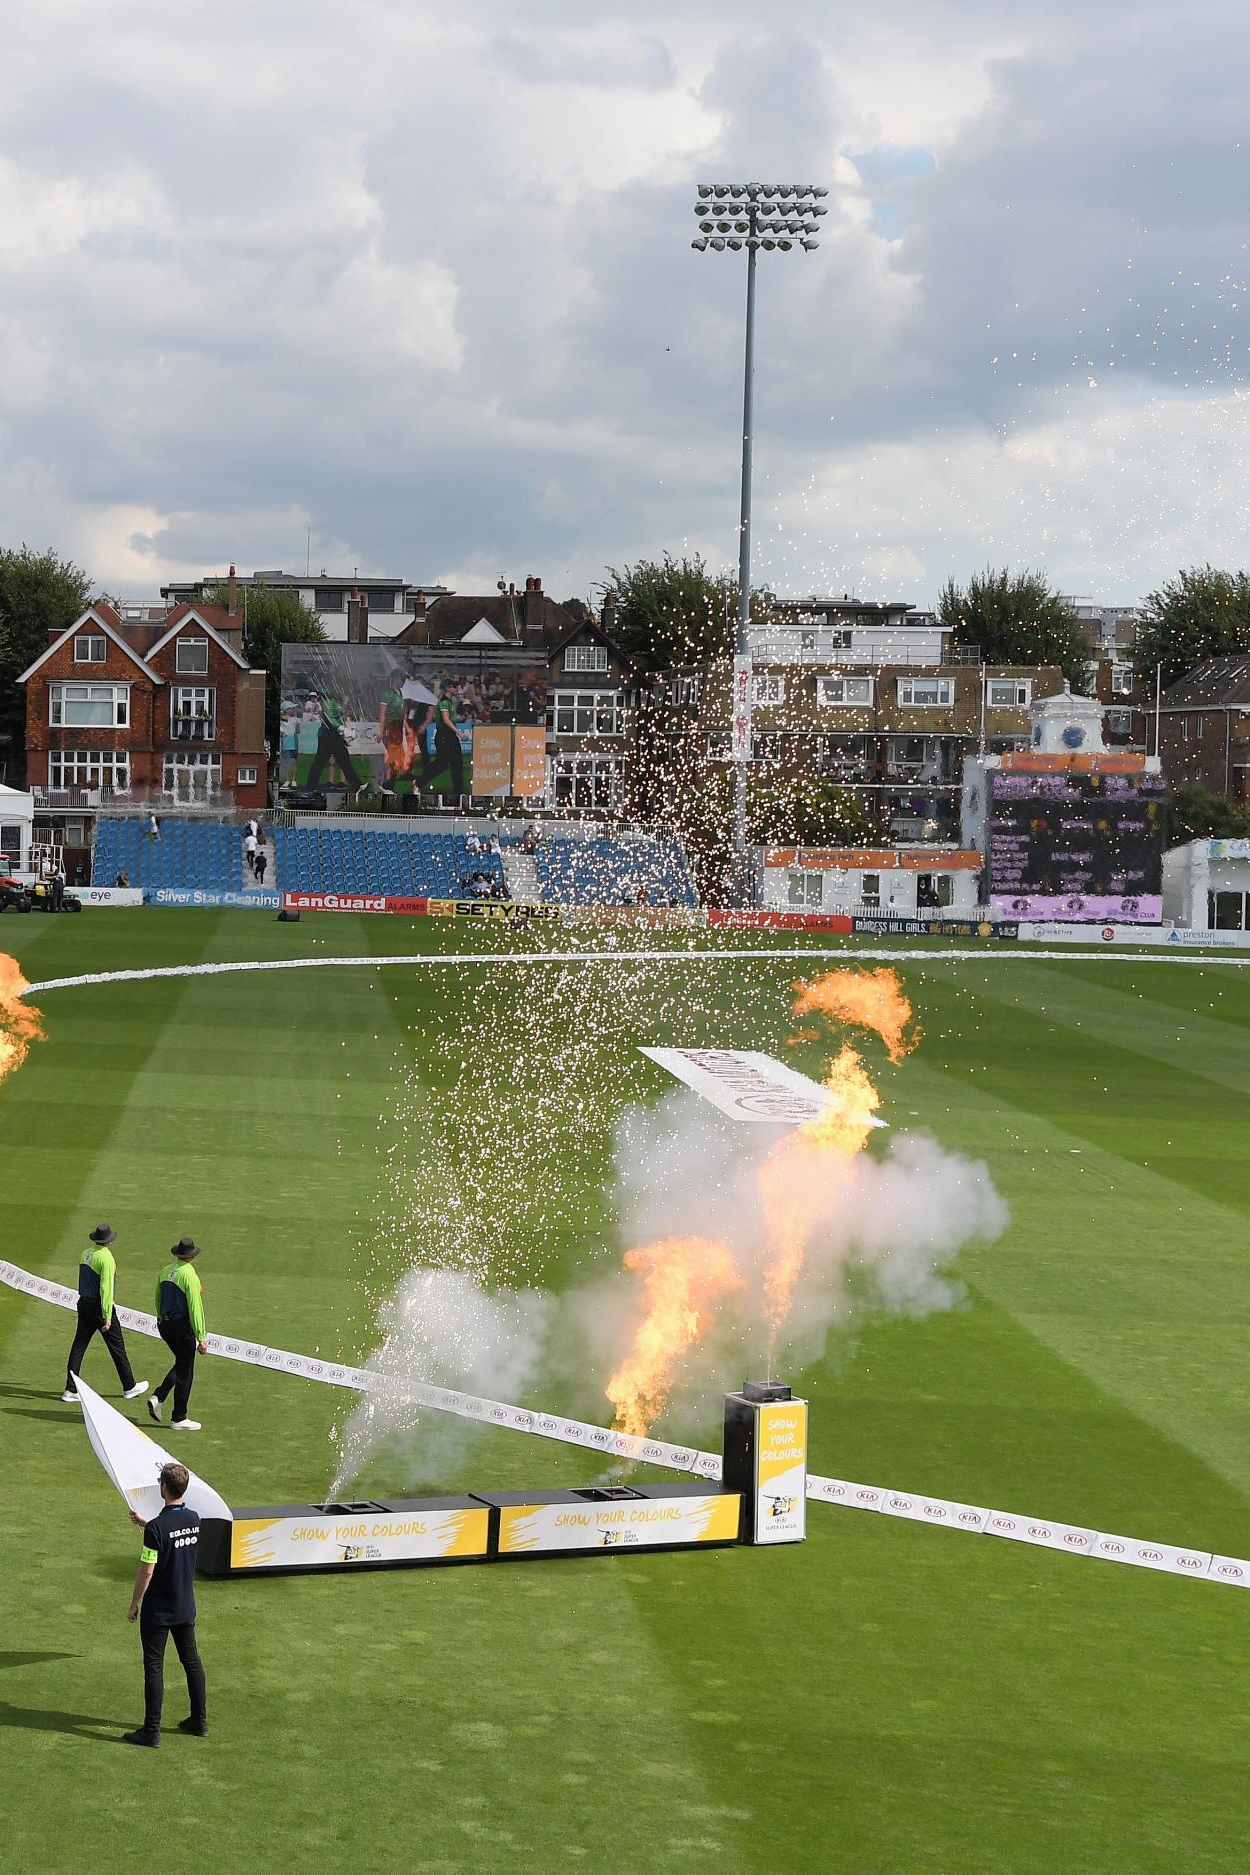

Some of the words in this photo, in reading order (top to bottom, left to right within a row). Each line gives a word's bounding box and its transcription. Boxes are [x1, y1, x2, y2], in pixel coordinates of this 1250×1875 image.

[90, 891, 111, 901] eye
[156, 890, 189, 902] Silver
[194, 890, 220, 904] Star
[286, 893, 386, 910] LanGuard
[387, 902, 426, 912] ALARMS
[455, 902, 560, 919] SETYRES
[889, 922, 903, 932] HILL
[1183, 931, 1215, 942] preston
[767, 1419, 797, 1430] SHOW
[770, 1433, 795, 1445] YOUR
[761, 1448, 803, 1461] COLOURS
[555, 1513, 590, 1527] SHOW
[596, 1510, 624, 1525] YOUR
[630, 1508, 682, 1523] COLOURS
[290, 1526, 329, 1541] SHOW
[335, 1524, 366, 1540] YOUR
[372, 1522, 427, 1537] COLOURS
